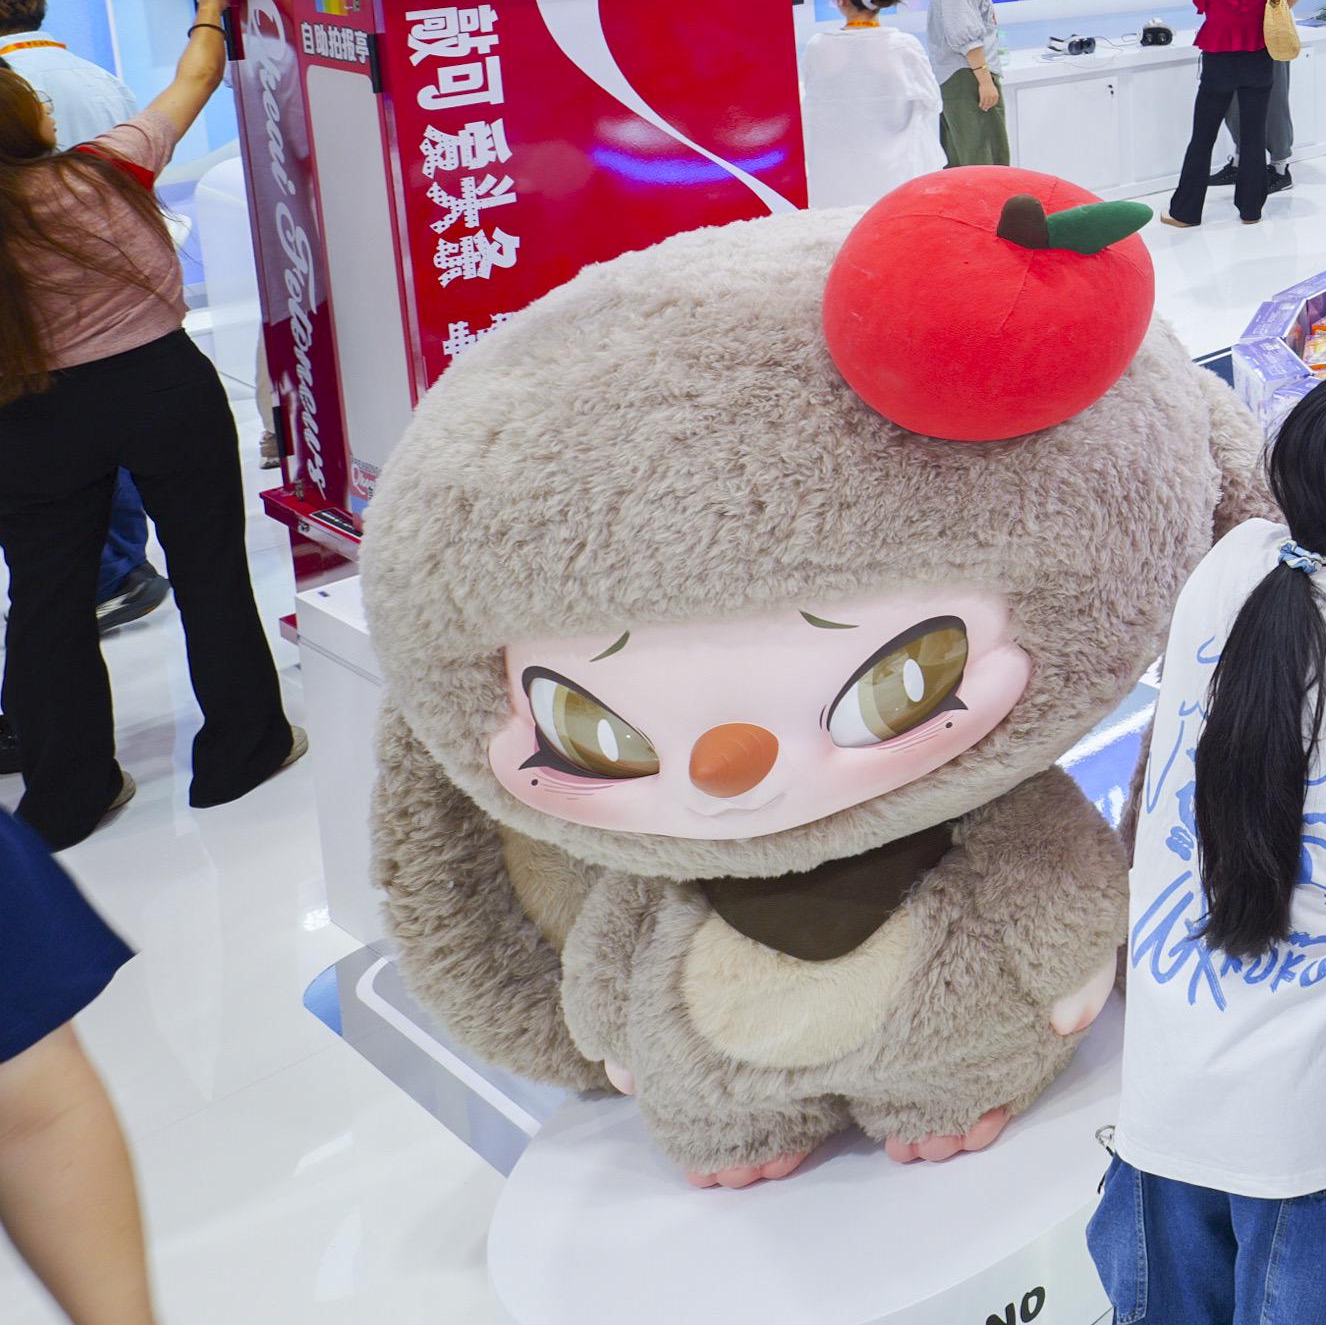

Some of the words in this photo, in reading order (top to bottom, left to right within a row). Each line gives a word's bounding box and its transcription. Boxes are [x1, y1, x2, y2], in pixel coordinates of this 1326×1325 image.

[300, 19, 370, 64] 自助拍报亭
